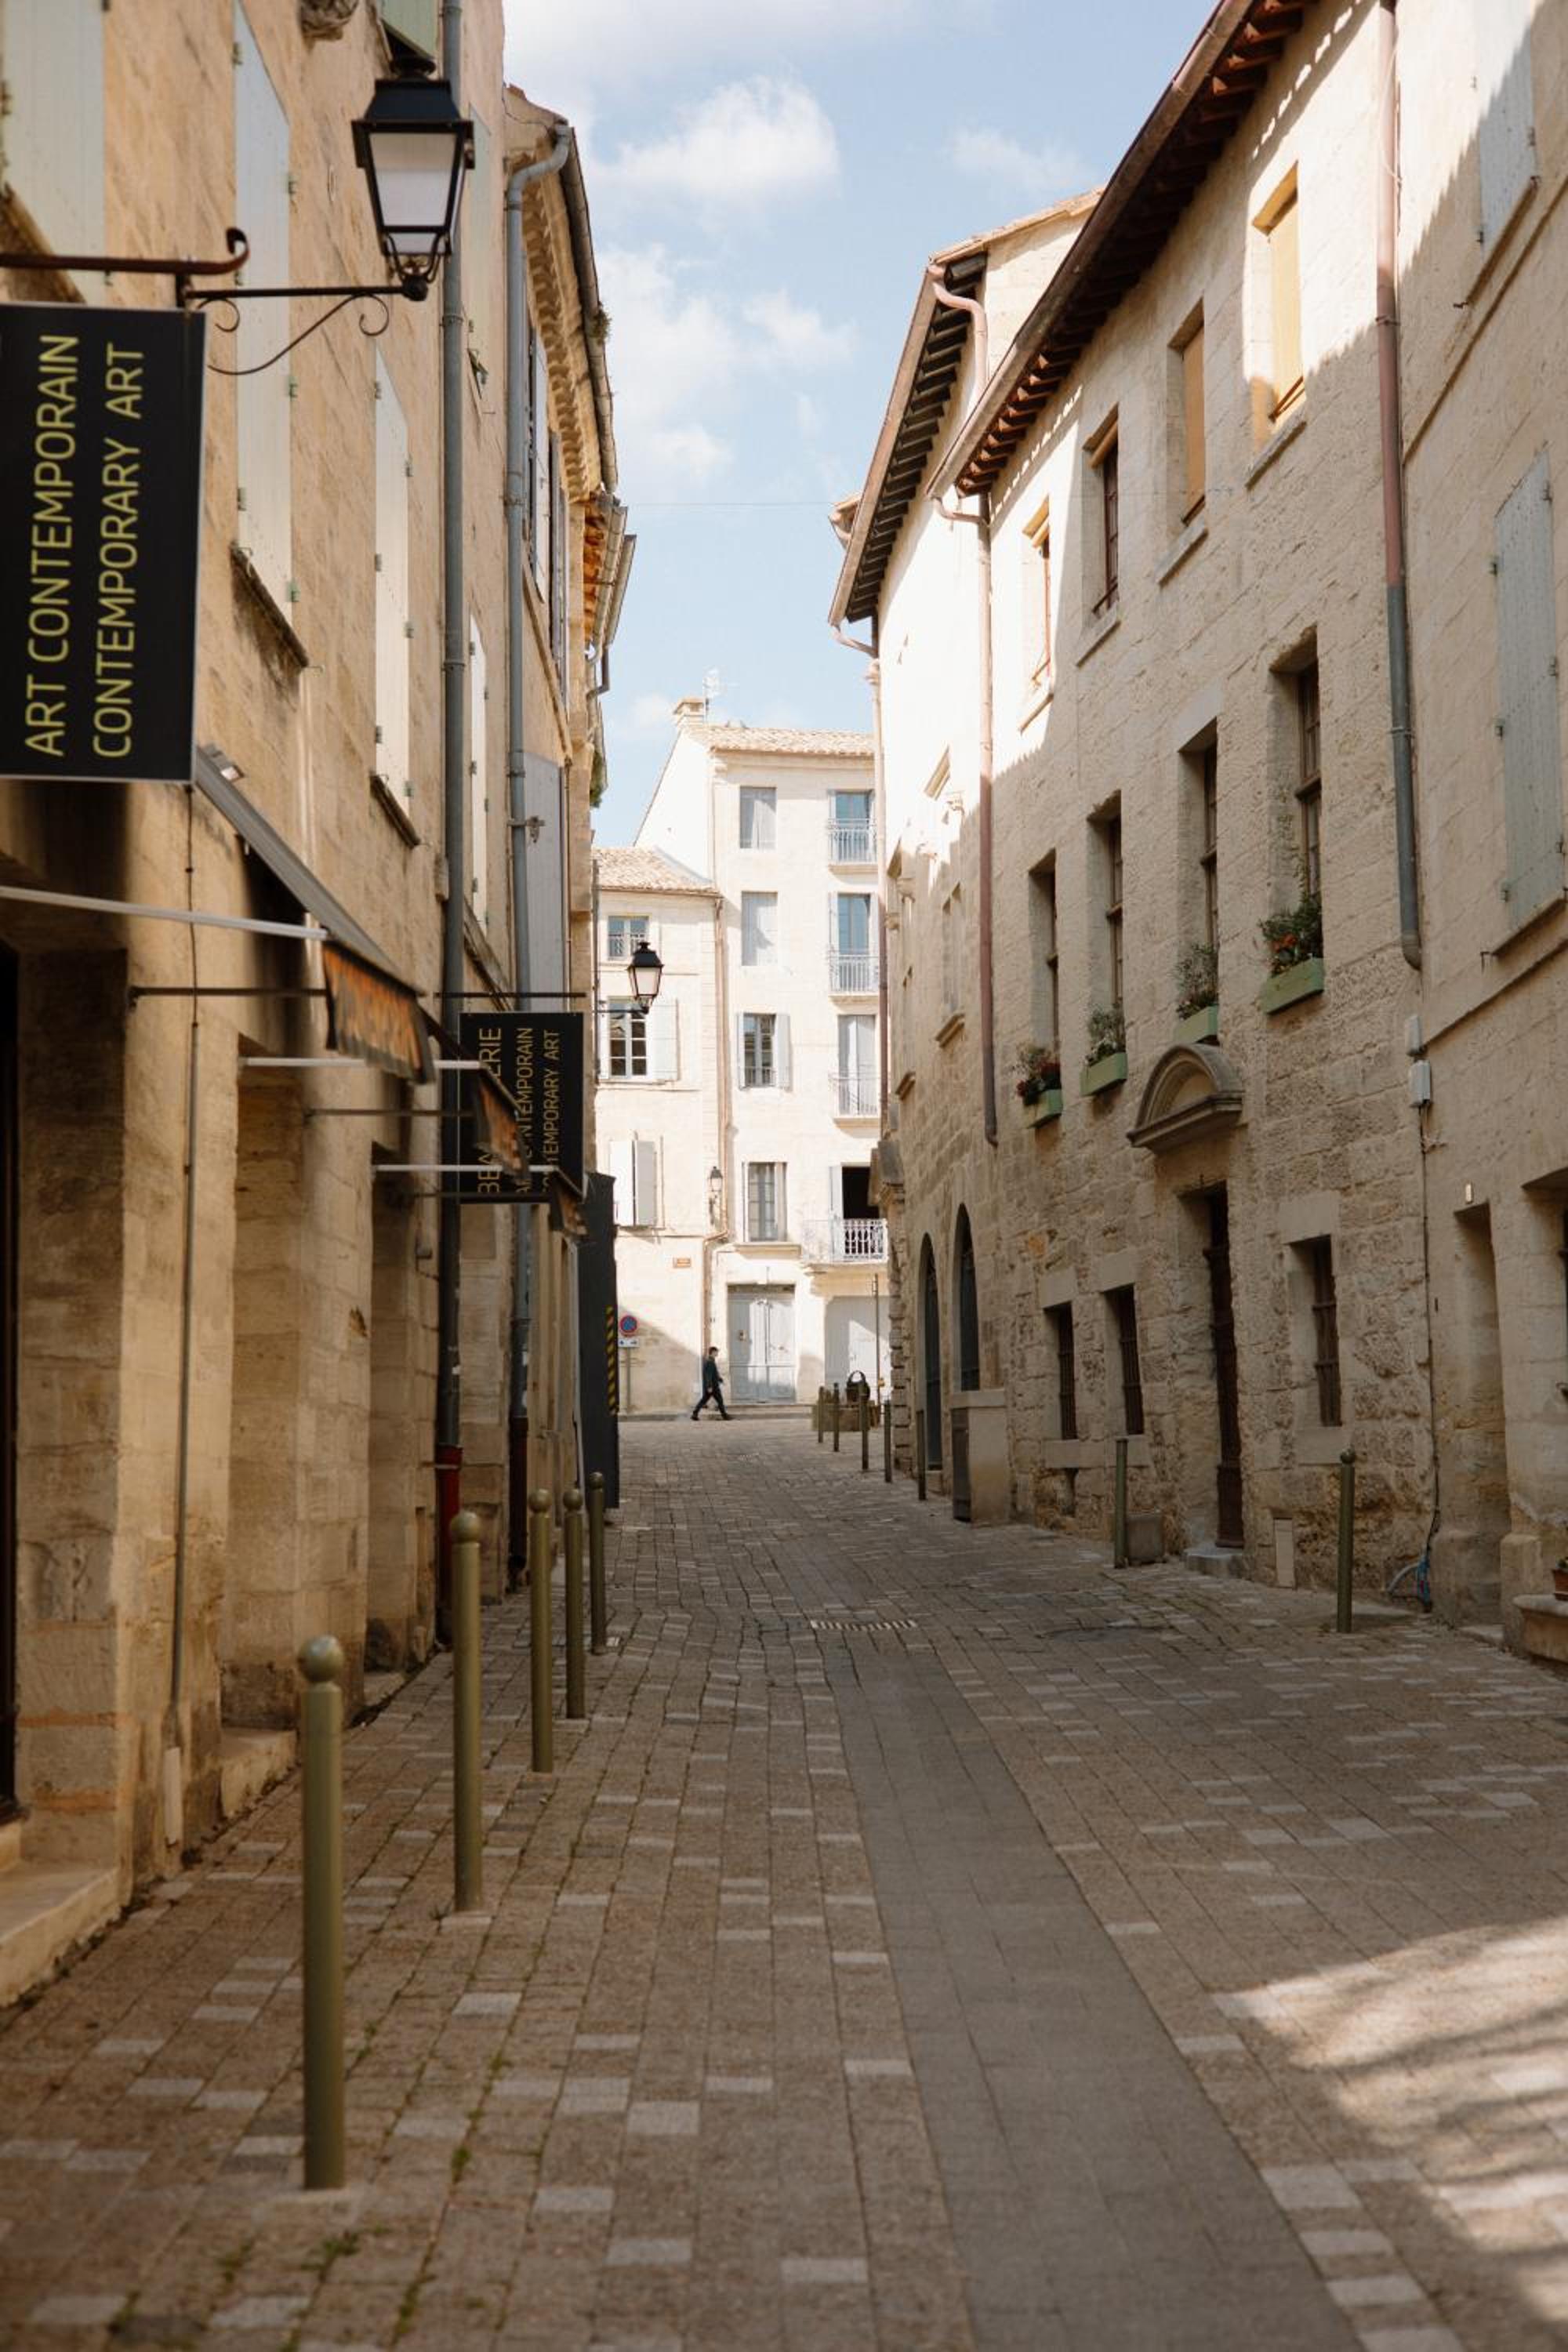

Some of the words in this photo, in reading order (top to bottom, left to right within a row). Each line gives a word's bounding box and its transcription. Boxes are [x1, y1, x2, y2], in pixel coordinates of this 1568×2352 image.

[104, 342, 144, 419] ART
[27, 335, 79, 662] CONTEMPORAIN
[92, 437, 140, 758] CONTEMPORARY
[25, 673, 67, 757] ART
[543, 1029, 560, 1061] ART
